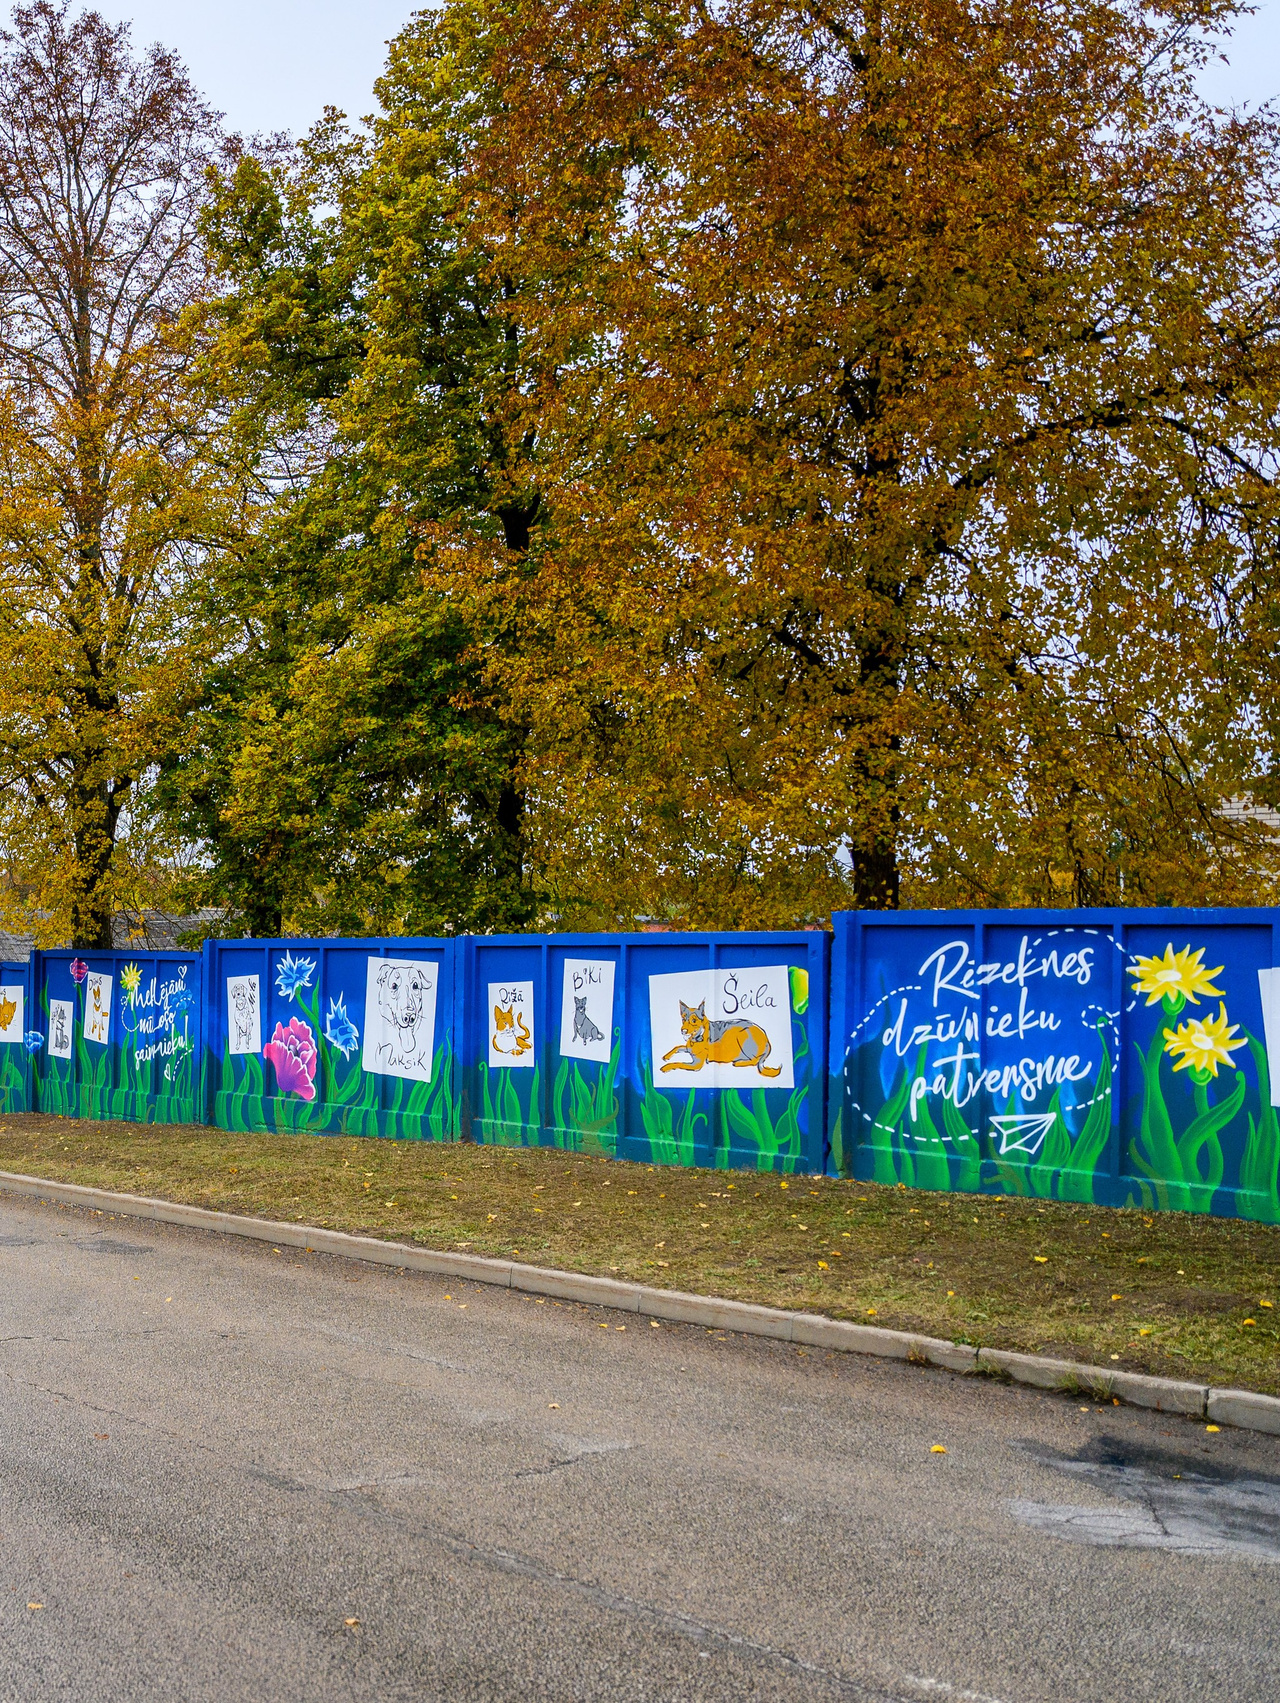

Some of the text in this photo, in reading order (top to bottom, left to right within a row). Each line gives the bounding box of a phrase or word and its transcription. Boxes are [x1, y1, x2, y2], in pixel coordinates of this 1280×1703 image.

[722, 972, 778, 1014] Šeila
[882, 986, 1061, 1056] dzīvnieku
[909, 1041, 1093, 1122] patversme
